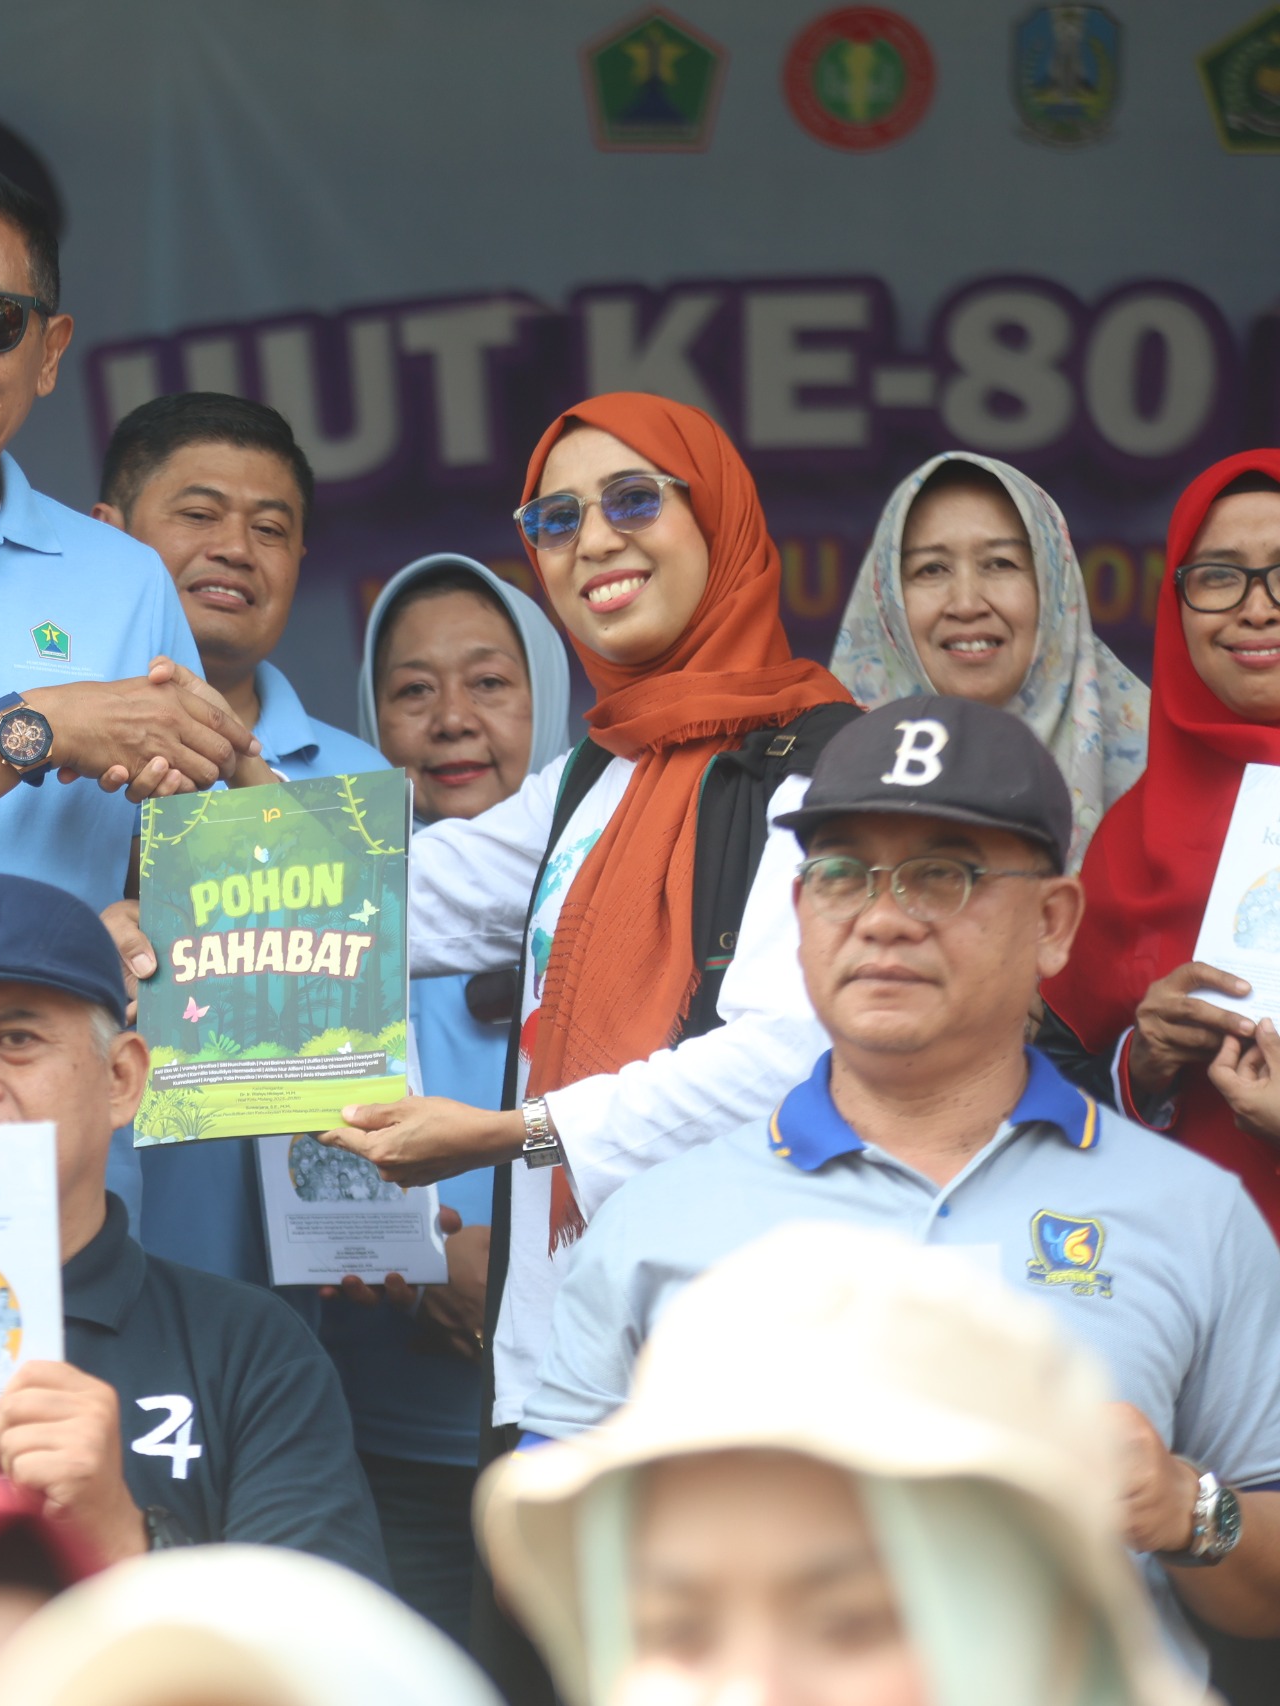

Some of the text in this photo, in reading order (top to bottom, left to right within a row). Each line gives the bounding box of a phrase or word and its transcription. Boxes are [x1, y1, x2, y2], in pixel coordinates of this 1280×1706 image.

[584, 288, 1220, 458] KE-80
[880, 718, 949, 786] B
[191, 862, 344, 927] POHON
[172, 930, 371, 983] SAHABAT
